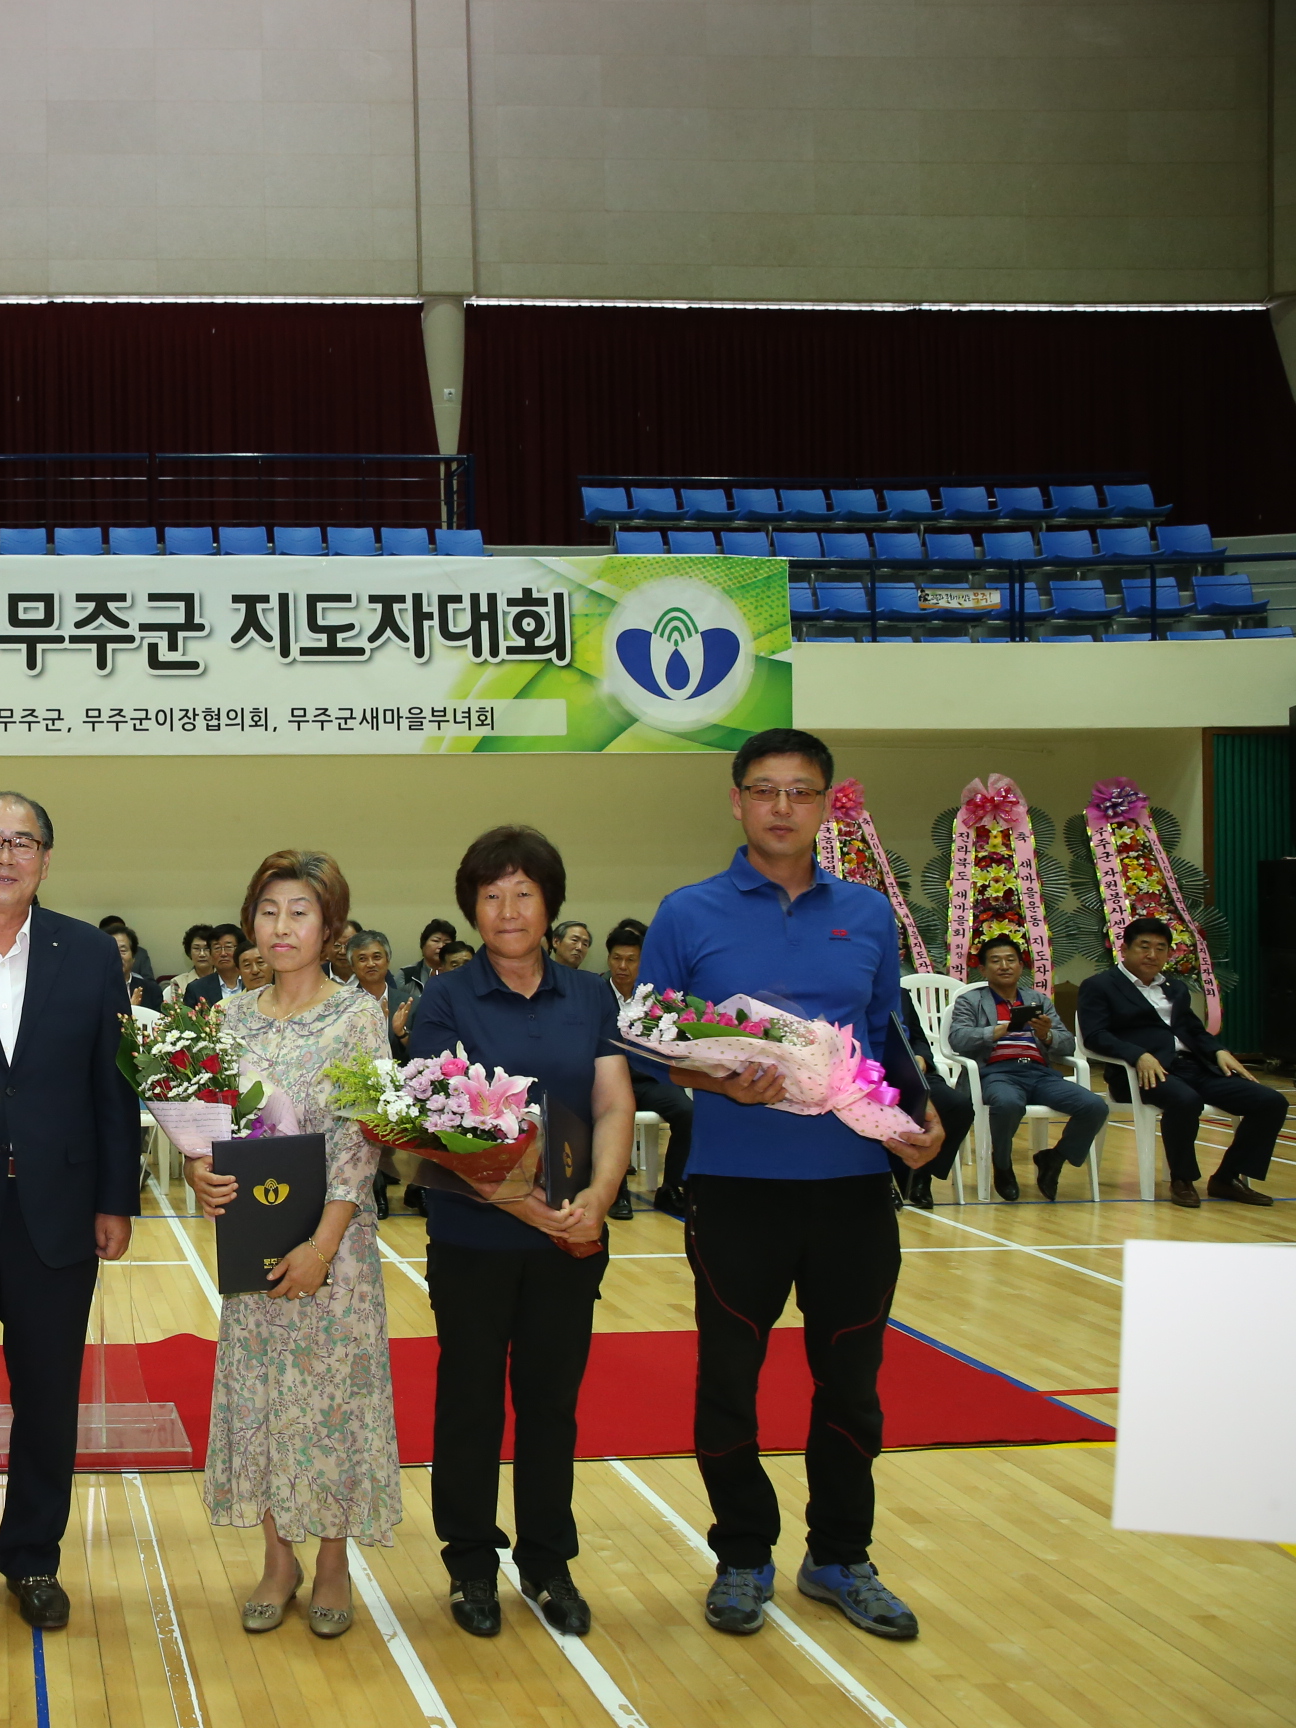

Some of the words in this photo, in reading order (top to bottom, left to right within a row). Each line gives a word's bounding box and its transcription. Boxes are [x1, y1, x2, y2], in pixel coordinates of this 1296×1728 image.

[229, 588, 569, 665] 지도자대회
[81, 707, 279, 733] 무주군이장협의회,
[287, 706, 496, 732] 무주군새마을부녀회
[954, 831, 971, 881] 전라북도
[1014, 831, 1030, 843] 축
[952, 889, 969, 939] 새마을회
[1018, 858, 1043, 928] 새마을운동
[902, 912, 932, 973] 새마을지도자
[1031, 934, 1051, 997] 지도자대
